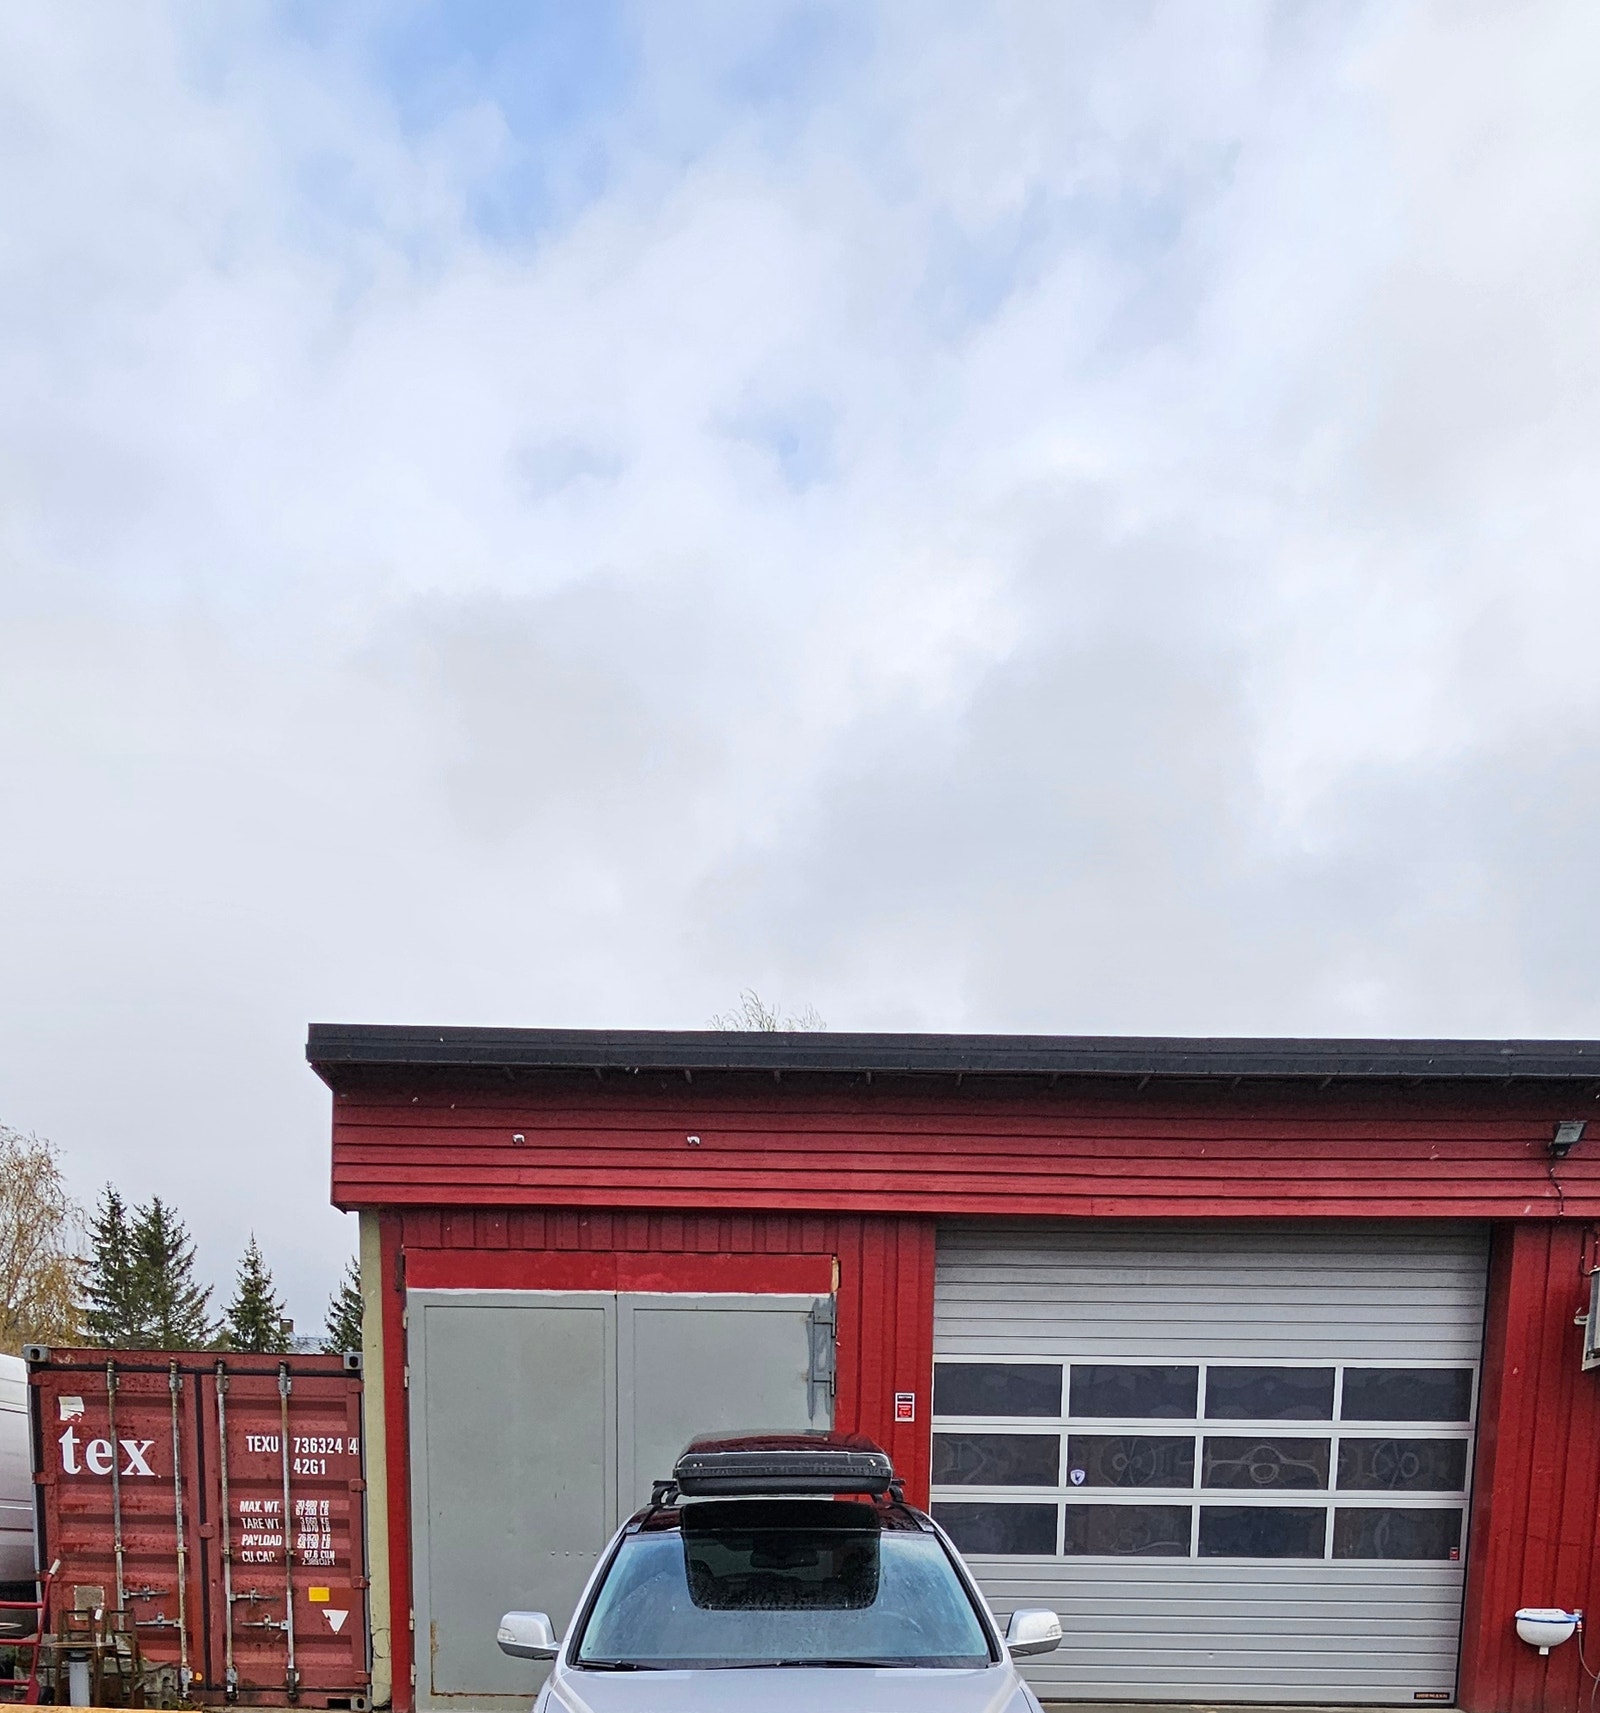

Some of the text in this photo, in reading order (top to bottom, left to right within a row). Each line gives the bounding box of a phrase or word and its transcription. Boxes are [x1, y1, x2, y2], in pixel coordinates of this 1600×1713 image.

[58, 1425, 155, 1476] tex
[245, 1435, 358, 1455] TEXU 736324 4
[293, 1458, 326, 1475] 42G1
[241, 1518, 265, 1530] TARE
[241, 1534, 282, 1546] PAYLOAD
